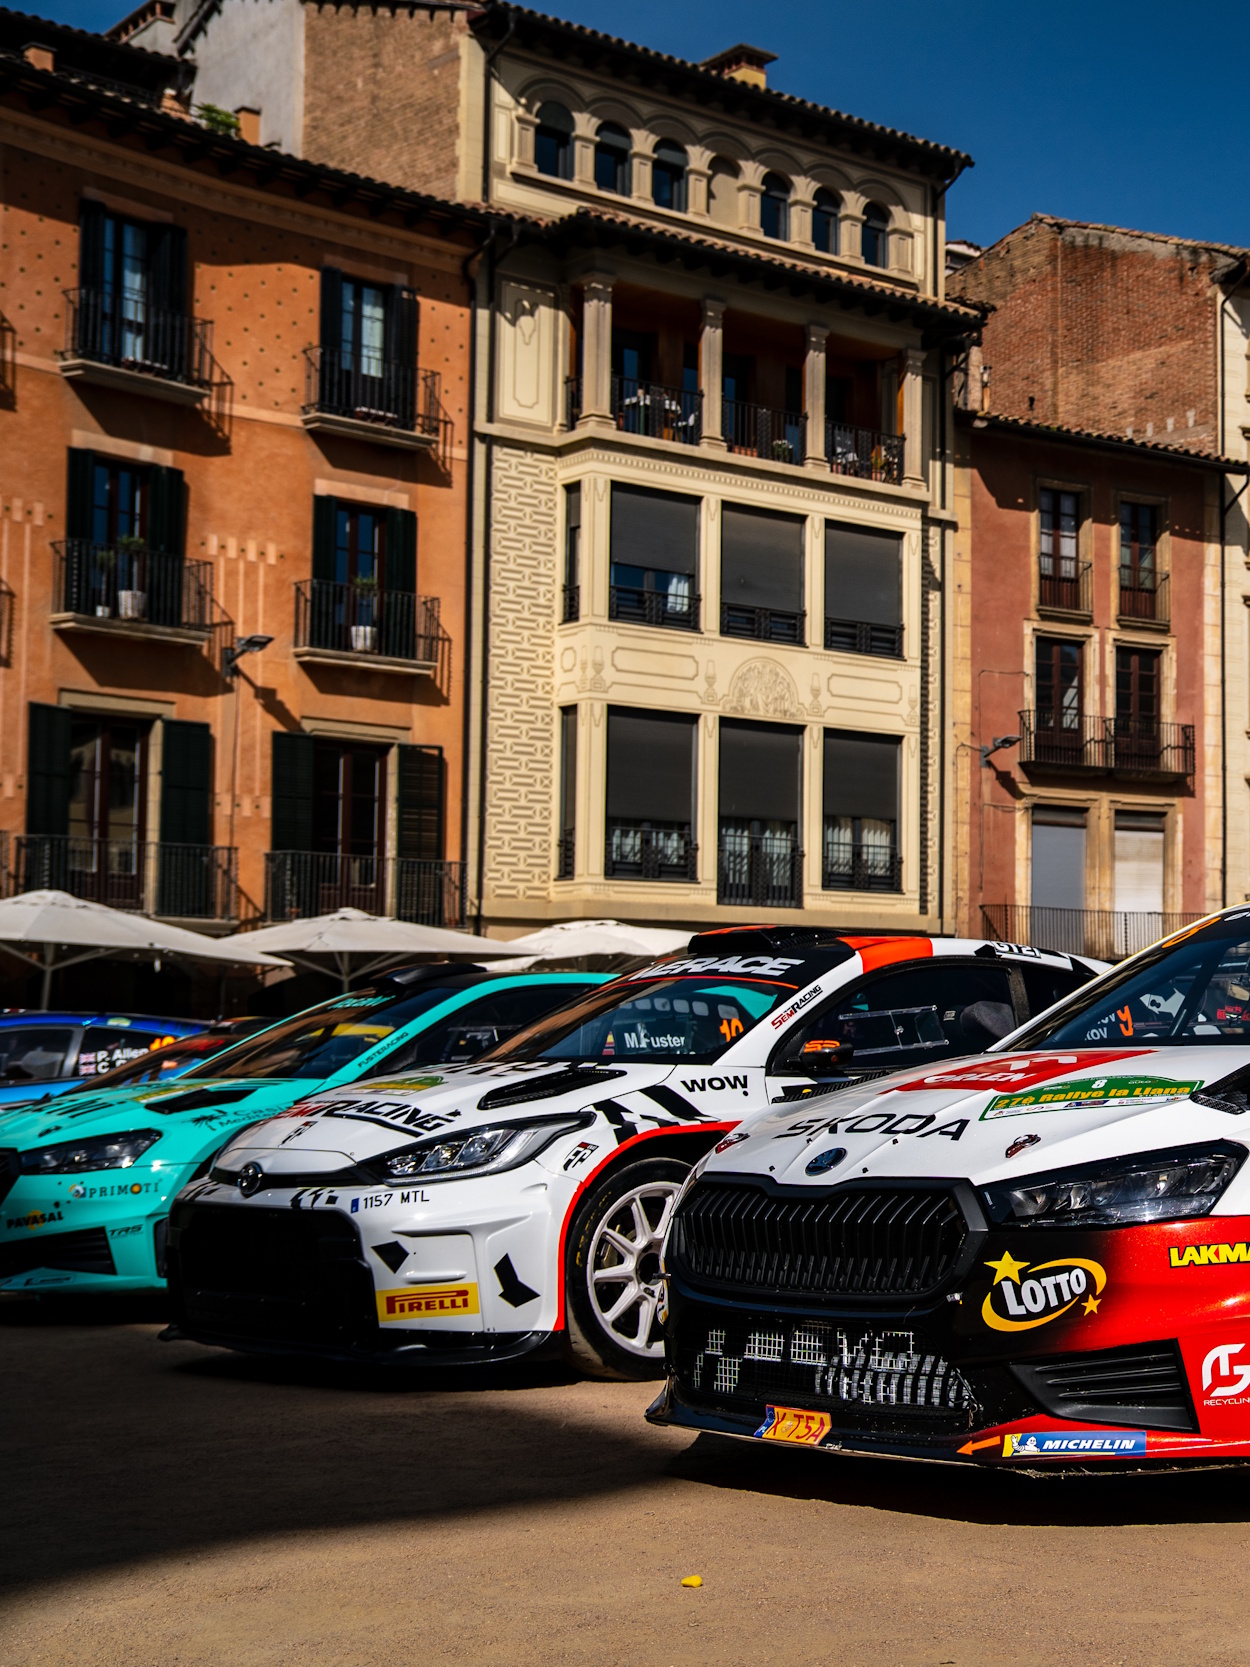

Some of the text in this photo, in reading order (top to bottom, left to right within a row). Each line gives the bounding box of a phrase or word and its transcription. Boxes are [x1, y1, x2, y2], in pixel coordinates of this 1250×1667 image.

[924, 1072, 1037, 1084] ORLEN
[1091, 1079, 1108, 1089] 8
[1039, 1087, 1107, 1102] Rallye
[1108, 1085, 1130, 1097] la
[1133, 1085, 1191, 1097] Llana
[772, 1113, 971, 1142] SKODA
[363, 1193, 394, 1209] 1157
[400, 1190, 430, 1204] MTL
[7, 1210, 64, 1230] PAVASAL
[1001, 1268, 1087, 1315] LOTTO
[386, 1289, 469, 1315] PIRELLI
[1042, 1439, 1136, 1450] MICHELIN
